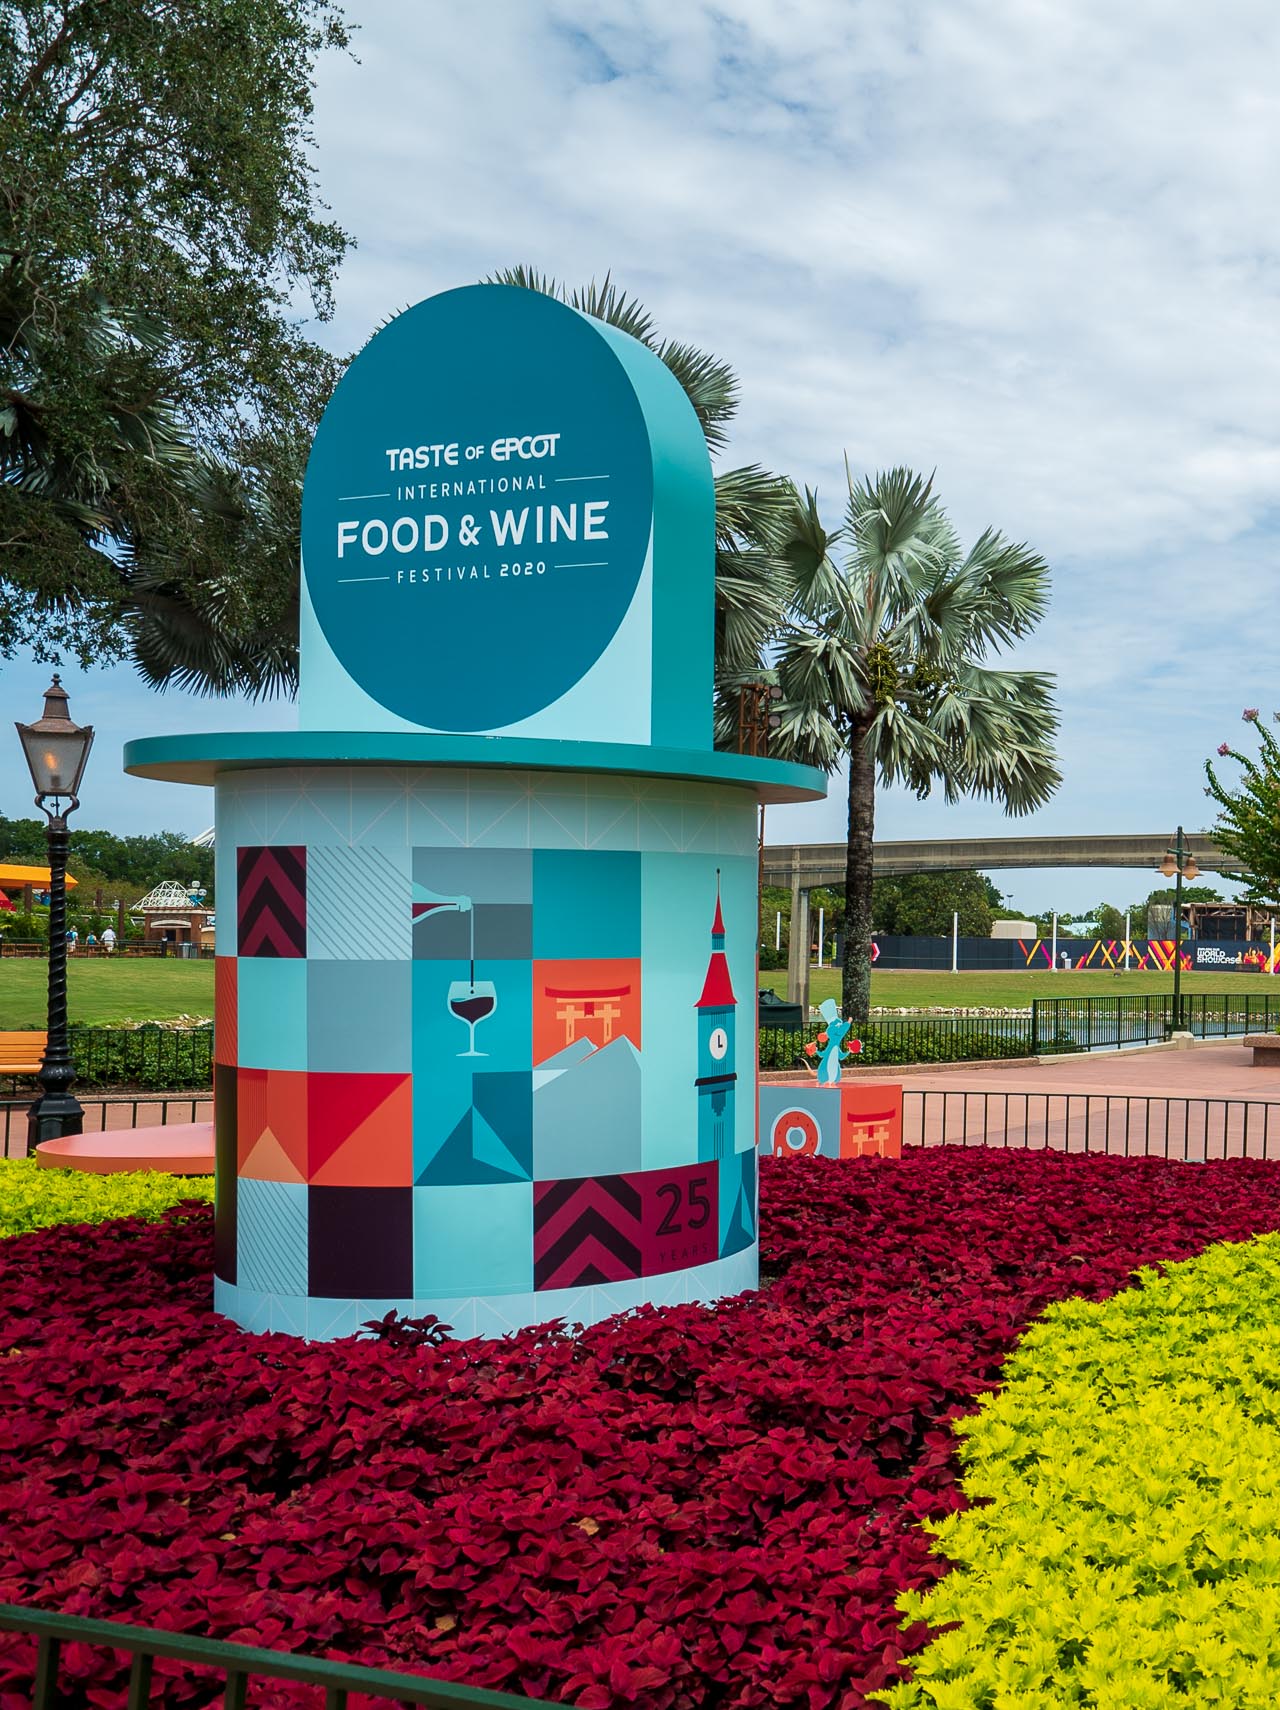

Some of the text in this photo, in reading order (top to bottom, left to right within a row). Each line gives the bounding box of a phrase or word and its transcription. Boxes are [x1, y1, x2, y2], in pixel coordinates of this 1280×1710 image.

[386, 433, 561, 472] TASTE OF EPCOT
[398, 474, 546, 501] INTERNATIONAL
[337, 501, 610, 558] FOOD & WINE
[397, 561, 546, 584] FESTIVAL 2020
[655, 1176, 711, 1237] 25
[659, 1242, 708, 1264] YEARS
